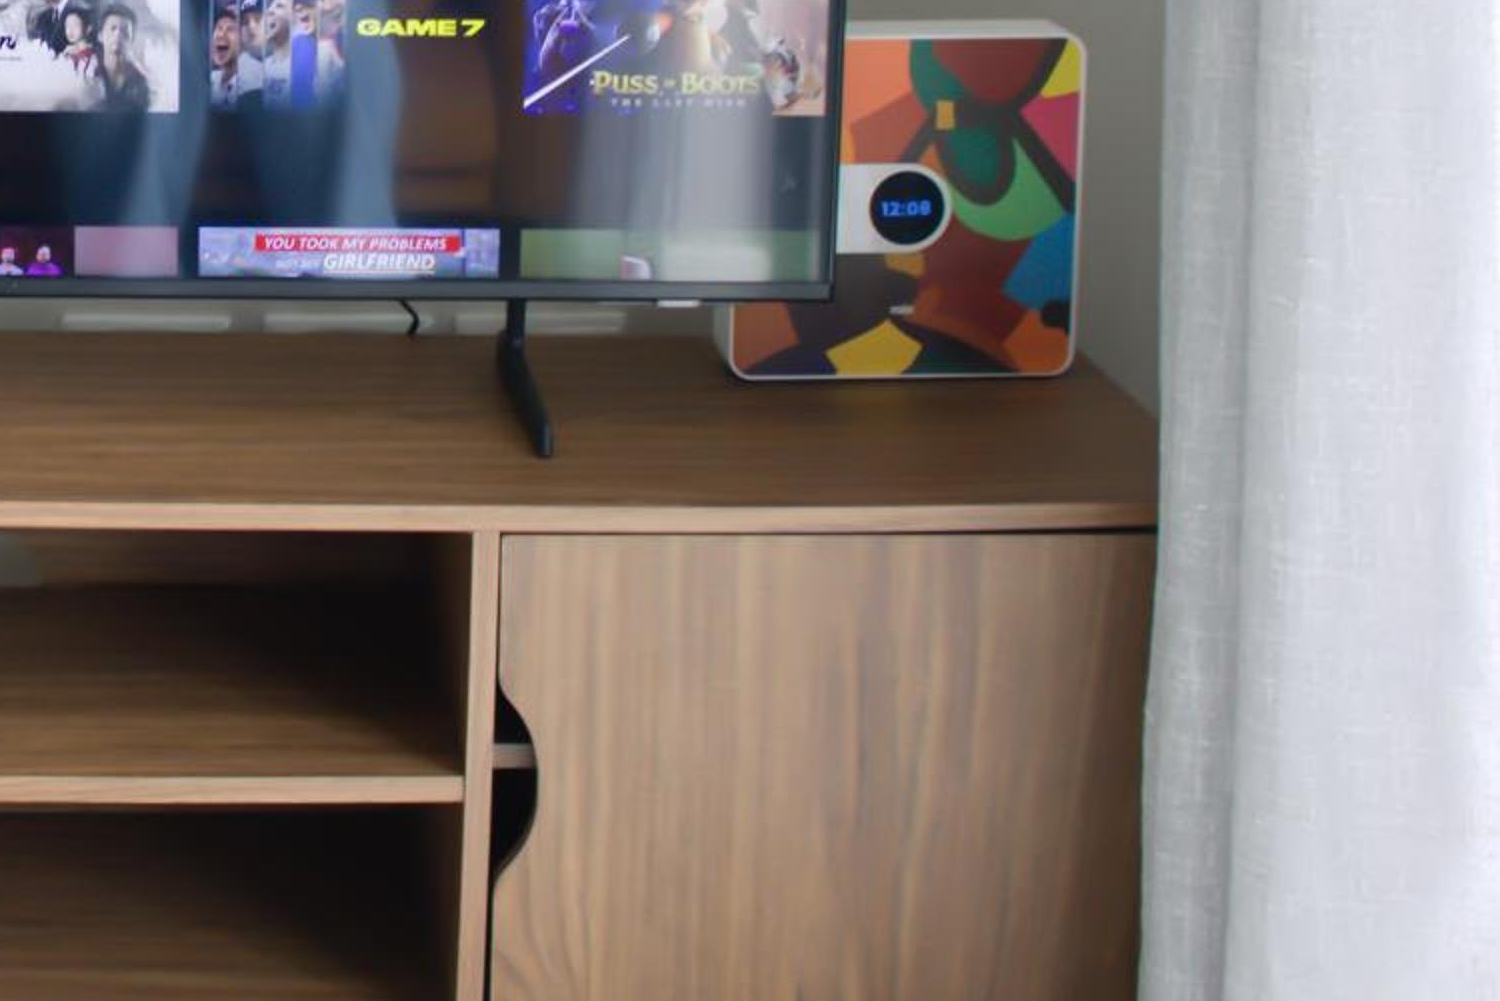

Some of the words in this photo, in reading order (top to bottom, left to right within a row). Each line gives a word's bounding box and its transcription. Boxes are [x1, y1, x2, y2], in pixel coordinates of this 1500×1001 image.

[356, 19, 457, 37] GAME
[461, 19, 485, 37] 7
[265, 237, 296, 250] YOU
[300, 237, 340, 250] TOOK
[343, 237, 368, 250] MY
[370, 237, 447, 250] PROBLEMS
[323, 252, 436, 270] GIRLFRIEND
